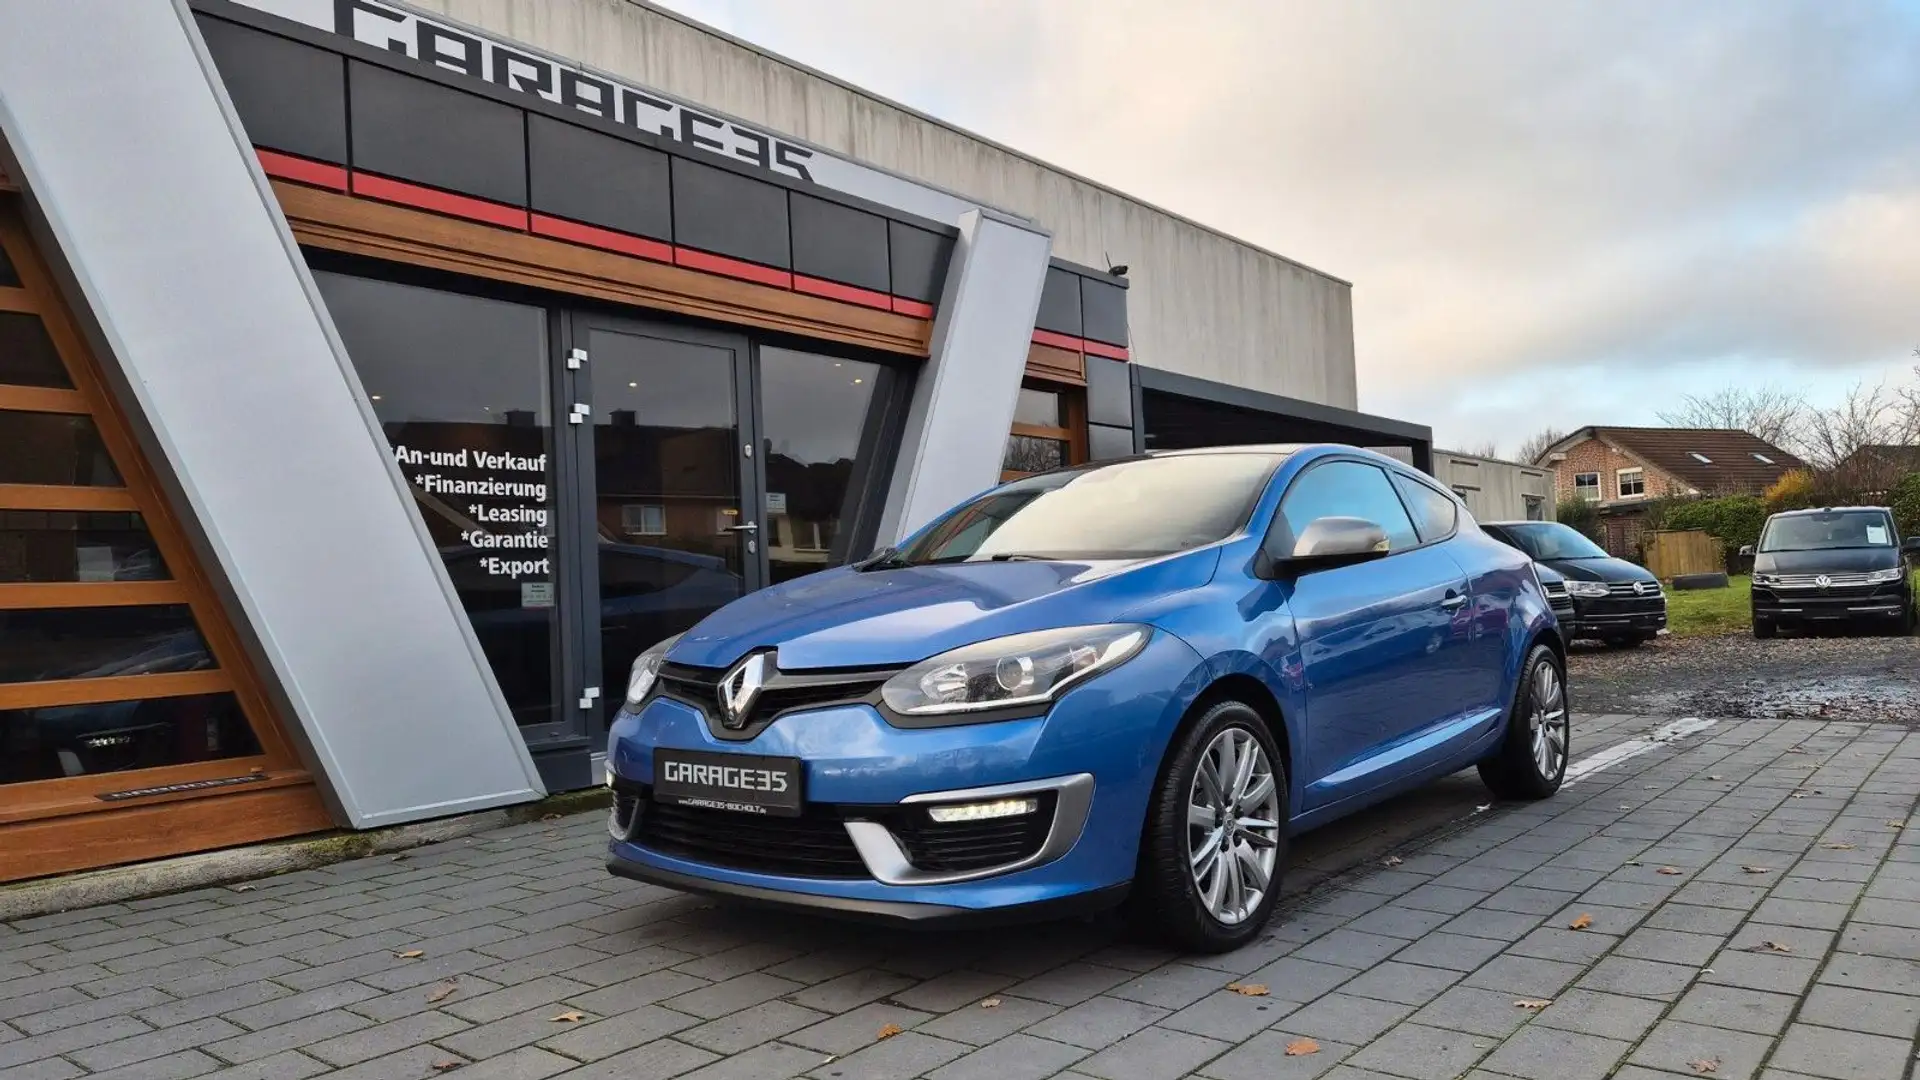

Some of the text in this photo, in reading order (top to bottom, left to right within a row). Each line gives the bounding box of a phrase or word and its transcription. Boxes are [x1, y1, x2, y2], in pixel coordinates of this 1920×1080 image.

[334, 0, 814, 182] GARAGE35
[473, 451, 547, 472] Verkauf
[664, 761, 788, 792] GARAGE35
